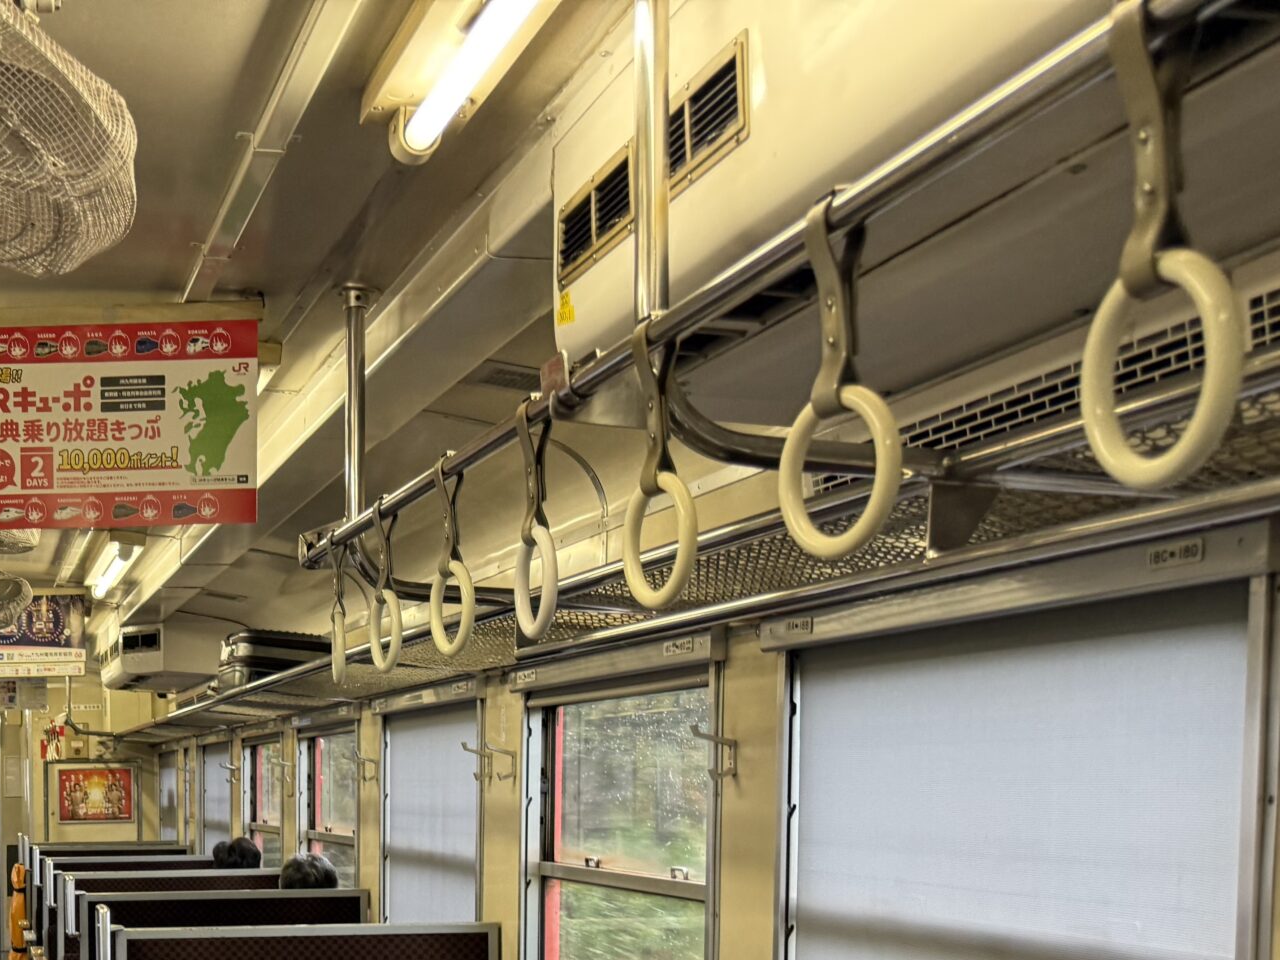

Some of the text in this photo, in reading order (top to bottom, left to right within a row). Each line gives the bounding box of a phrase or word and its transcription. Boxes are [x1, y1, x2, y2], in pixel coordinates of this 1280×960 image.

[232, 362, 250, 373] JR
[30, 456, 45, 478] 2
[26, 478, 49, 487] DAYS
